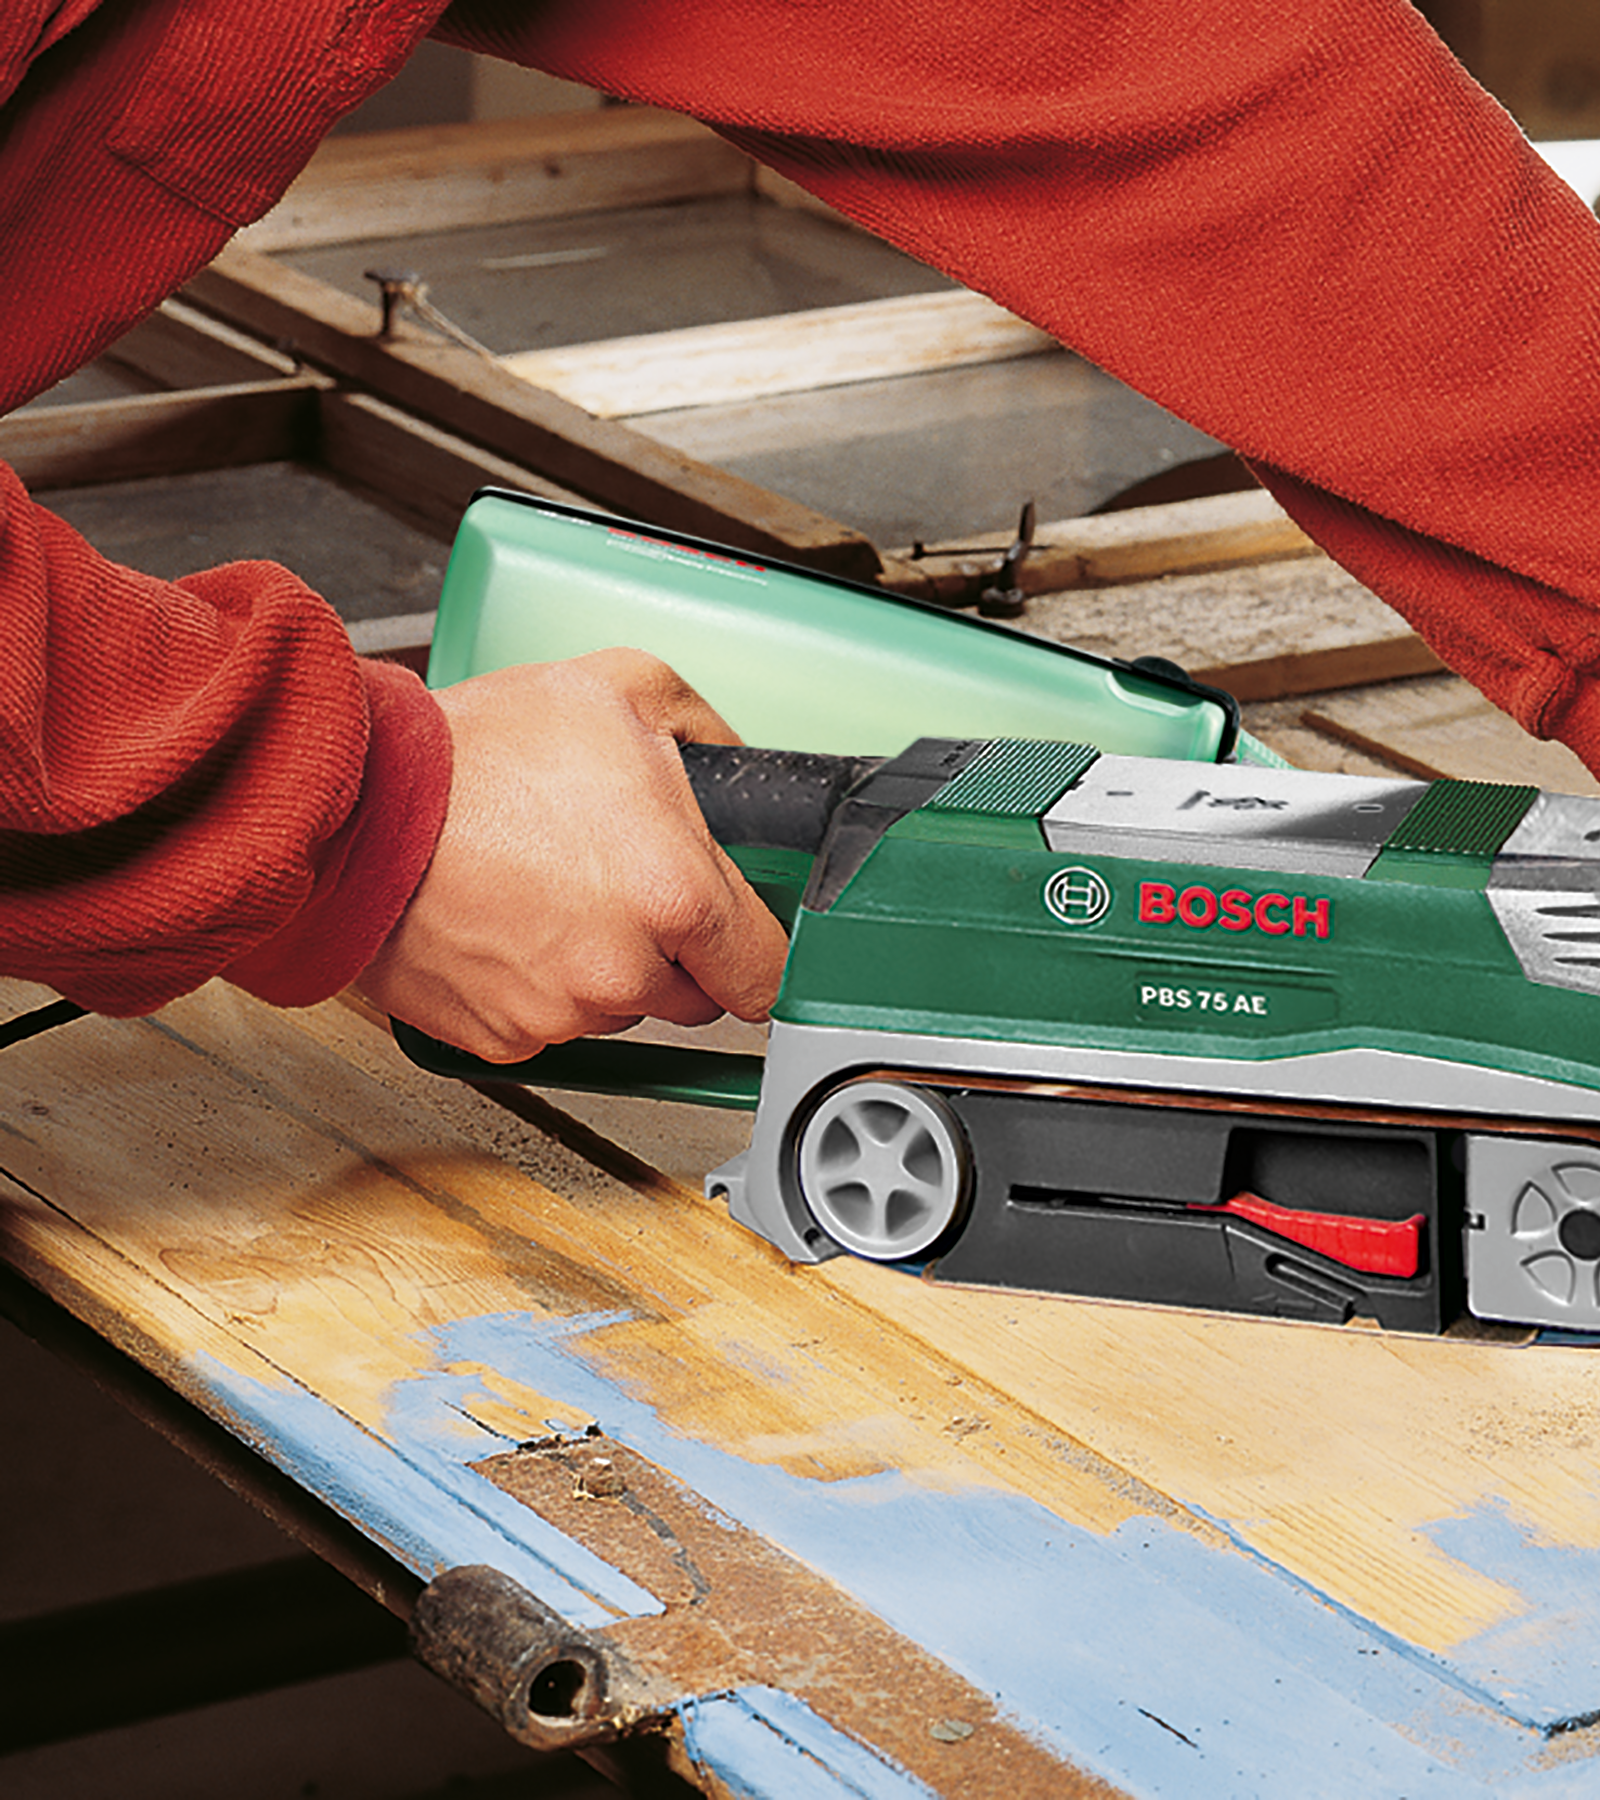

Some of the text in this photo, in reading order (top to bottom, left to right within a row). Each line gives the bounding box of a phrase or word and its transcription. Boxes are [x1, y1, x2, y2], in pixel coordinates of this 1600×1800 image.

[1138, 882, 1330, 938] BOSCH
[1141, 986, 1268, 1015] PBS 75 AE
